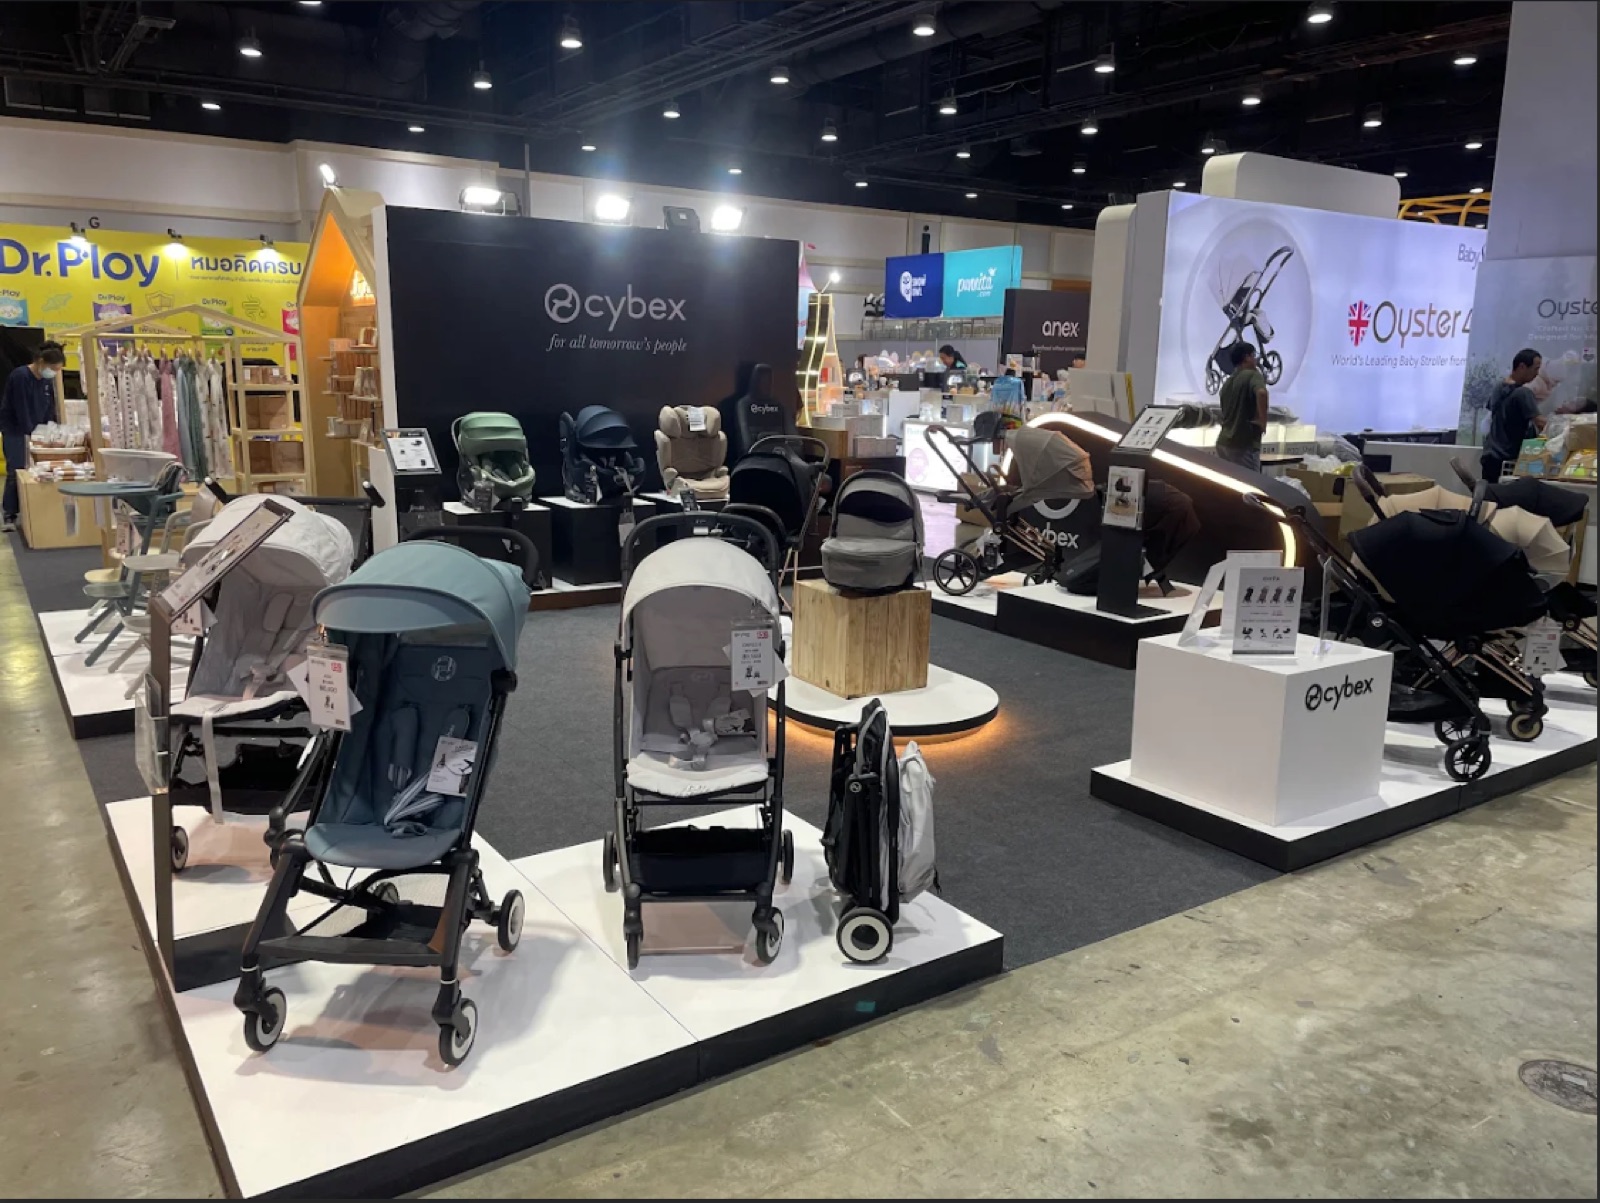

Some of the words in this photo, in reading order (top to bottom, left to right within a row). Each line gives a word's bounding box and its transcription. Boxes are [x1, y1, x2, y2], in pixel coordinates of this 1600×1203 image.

[88, 216, 100, 229] G
[1457, 243, 1481, 270] Baby
[584, 283, 687, 332] cybex
[1041, 320, 1079, 338] anex
[1373, 300, 1462, 349] Oyster
[545, 333, 567, 352] for
[569, 333, 586, 349] all
[589, 336, 651, 351] tomorrow's
[652, 337, 688, 356] people
[1331, 354, 1364, 367] World's
[1364, 355, 1397, 369] Leading
[1399, 354, 1420, 369] Baby
[1420, 355, 1449, 367] Stroller
[1322, 674, 1374, 711] cybex
